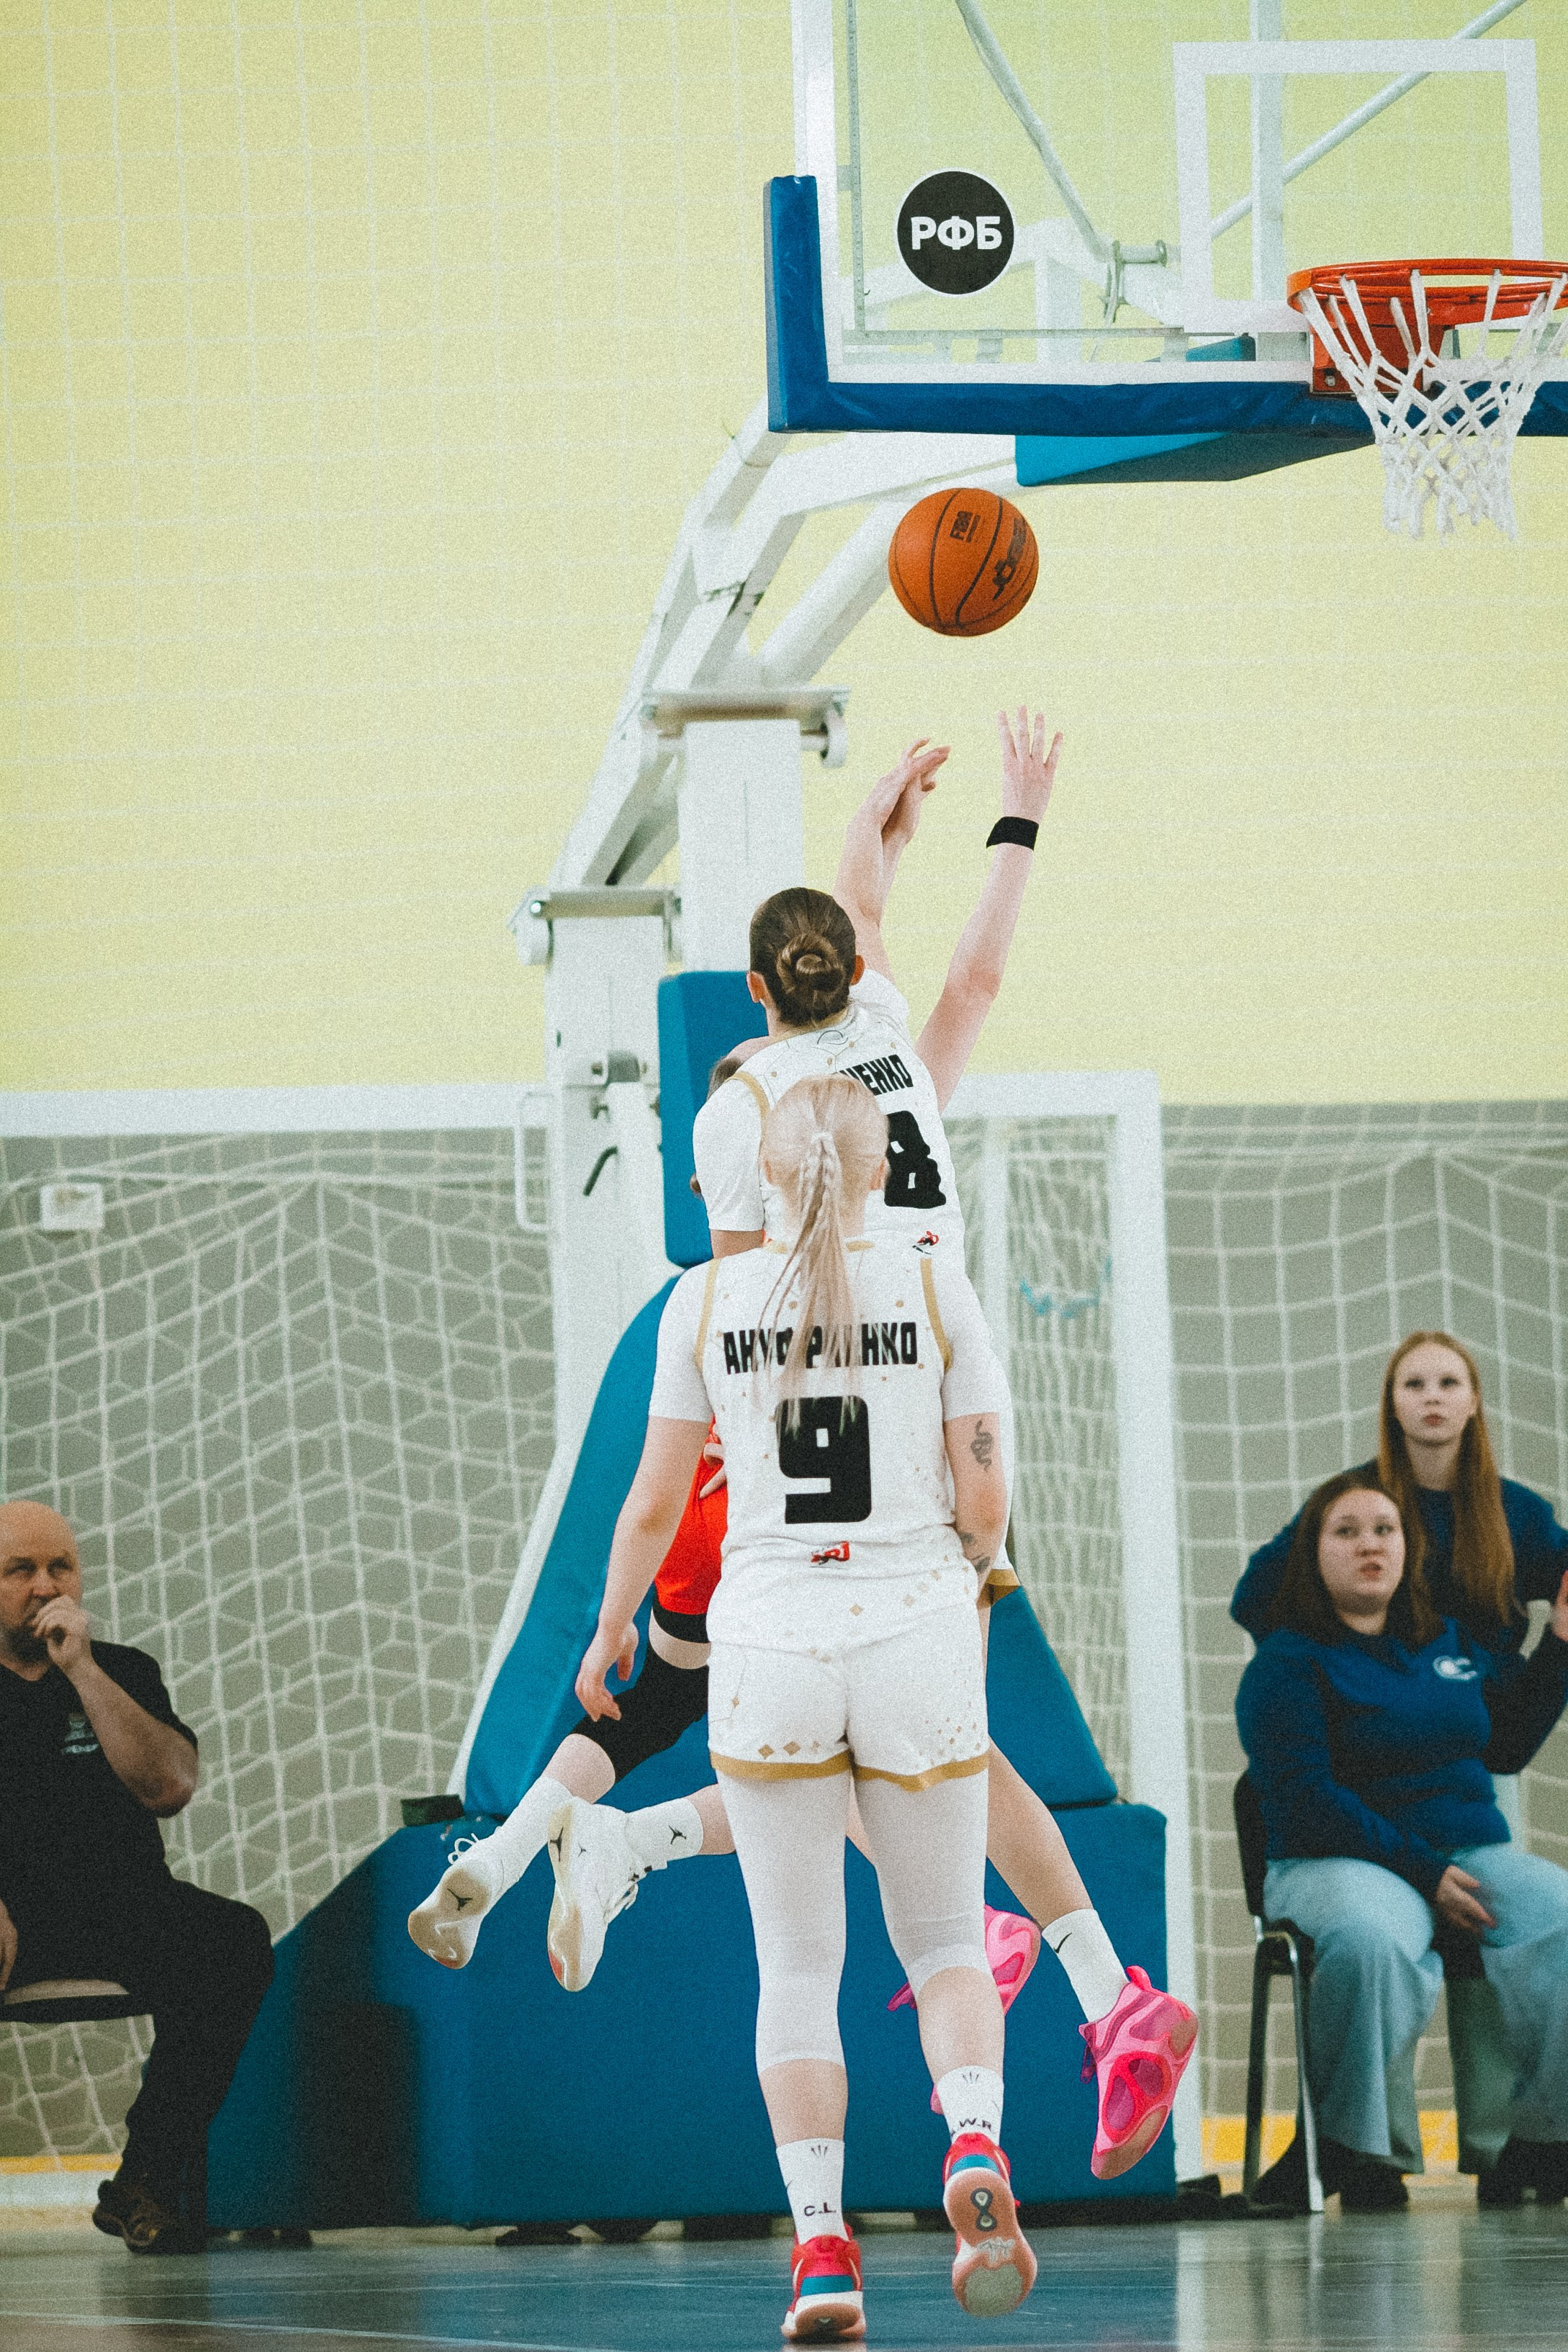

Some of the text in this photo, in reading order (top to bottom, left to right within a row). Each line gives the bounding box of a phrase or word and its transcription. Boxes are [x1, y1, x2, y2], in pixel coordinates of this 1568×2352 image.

[911, 215, 1003, 251] РФБ
[839, 1054, 914, 1096] ЕНКО
[776, 1395, 872, 1524] 9
